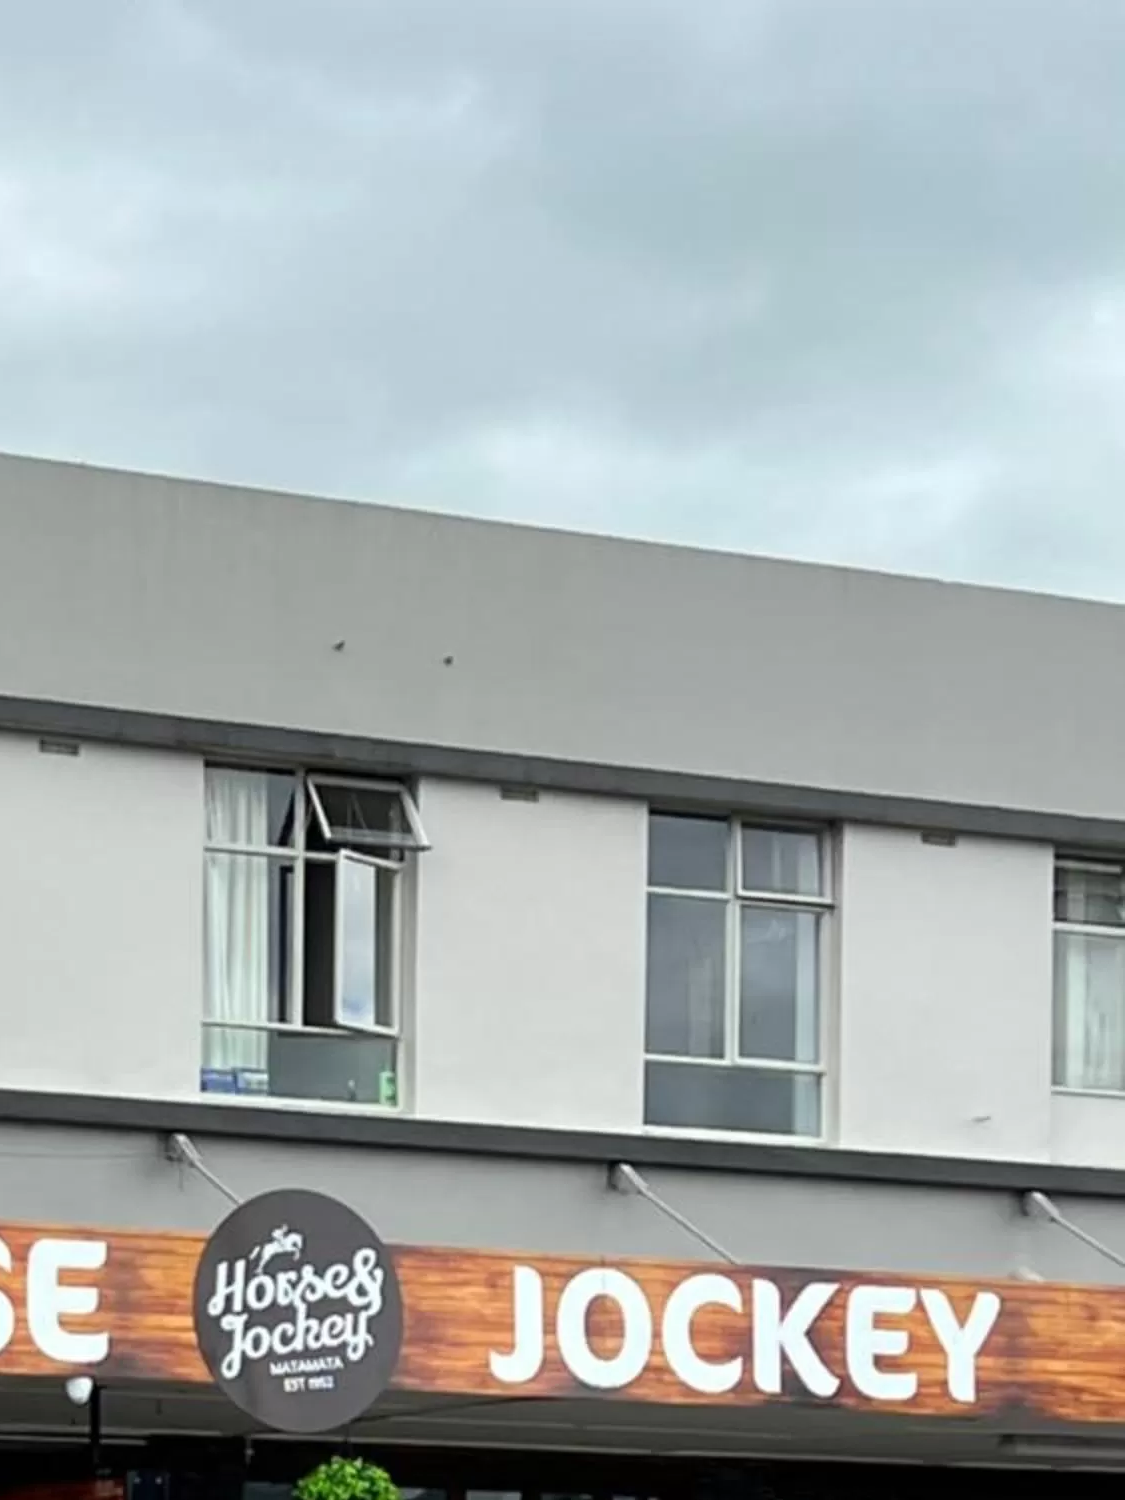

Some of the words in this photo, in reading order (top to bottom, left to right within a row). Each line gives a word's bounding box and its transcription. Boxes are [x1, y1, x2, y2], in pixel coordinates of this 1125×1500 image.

[220, 1304, 374, 1380] Jockey
[488, 1264, 1002, 1404] JOCKEY
[269, 1356, 344, 1376] MATAMATA
[283, 1377, 306, 1392] EST
